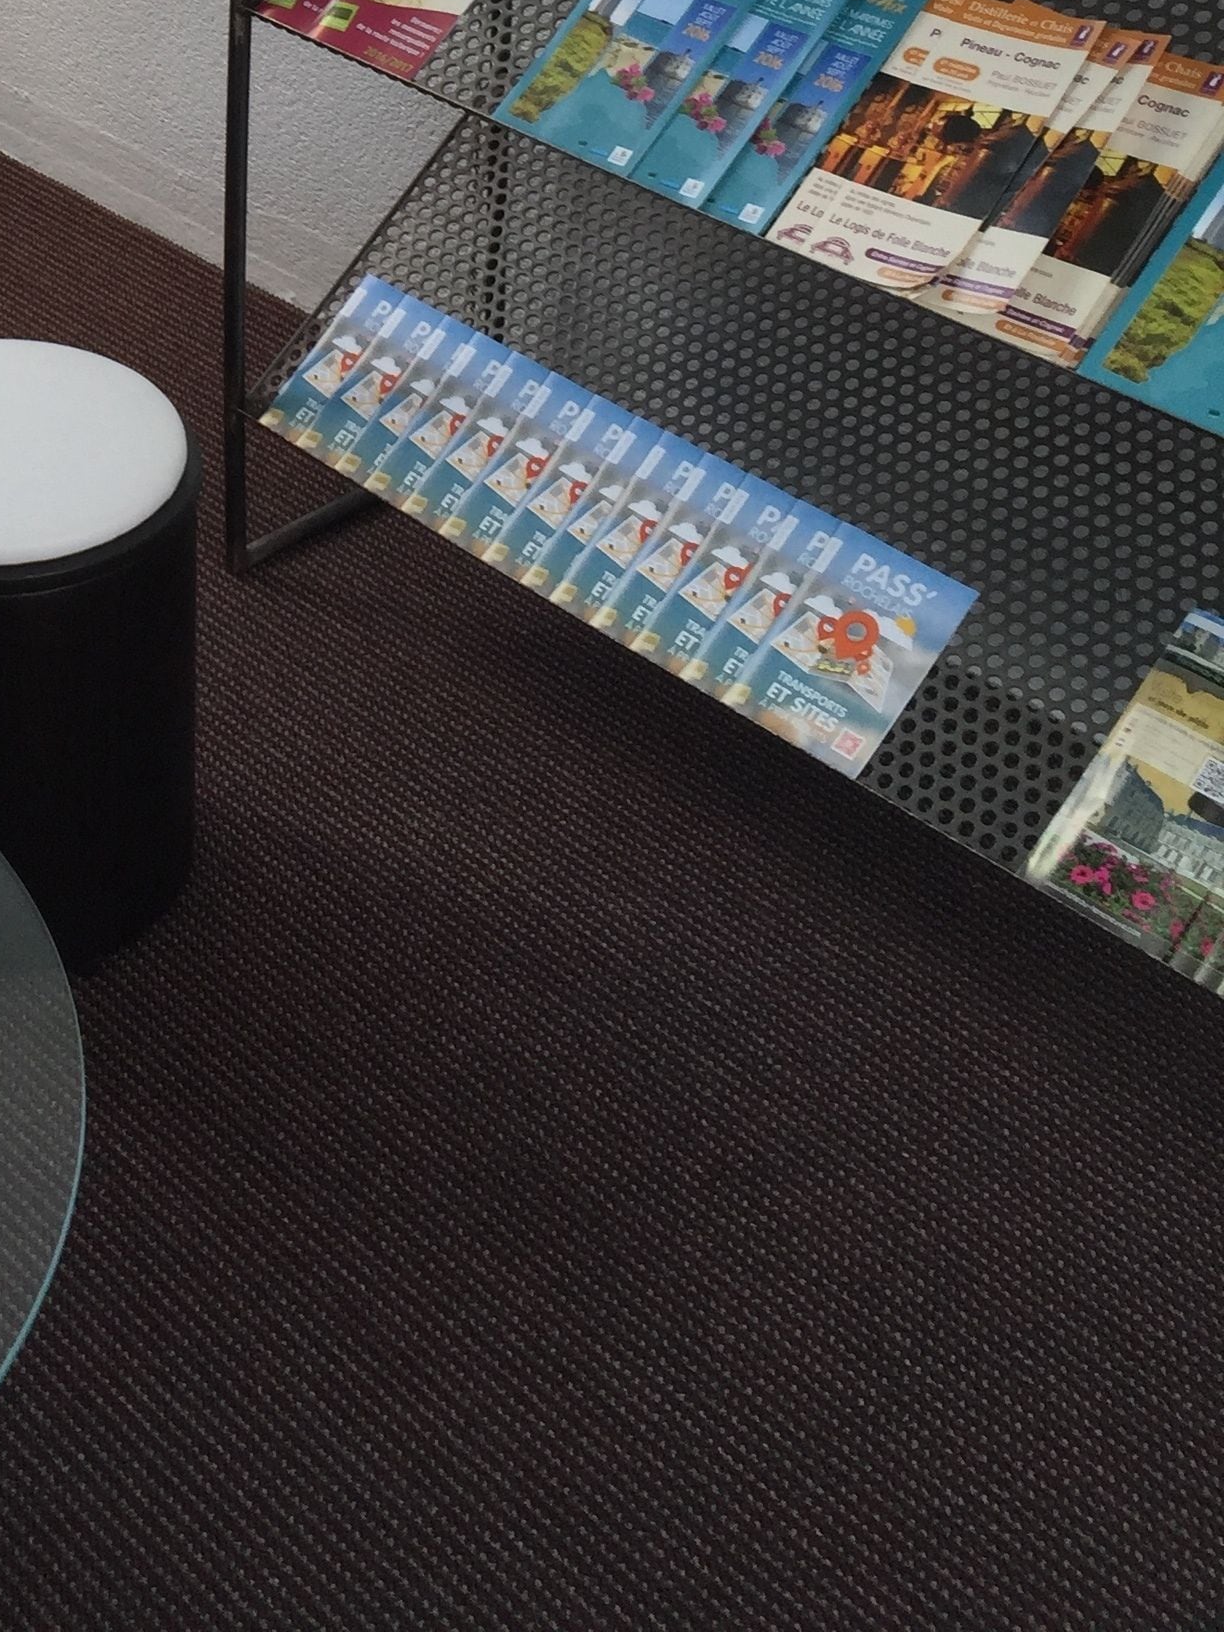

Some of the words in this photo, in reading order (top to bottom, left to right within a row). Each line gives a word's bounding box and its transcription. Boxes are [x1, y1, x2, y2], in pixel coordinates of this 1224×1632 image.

[967, 0, 1029, 26] Distillerie
[1039, 18, 1074, 35] Chais
[682, 23, 711, 43] 2016
[753, 51, 785, 71] 2016
[959, 37, 1004, 59] Pineau
[1013, 50, 1062, 71] Cognac
[1165, 61, 1203, 79] Chais
[813, 73, 846, 94] 2016
[1137, 94, 1191, 119] Cognac
[795, 200, 810, 213] Le
[828, 212, 843, 226] Le
[843, 219, 872, 236] Logis
[871, 228, 887, 241] de
[910, 239, 952, 258] Blanche
[1031, 293, 1078, 317] Blanche
[777, 669, 849, 718] TRANSPORTS
[765, 681, 793, 704] ET
[789, 697, 840, 734] SITES
